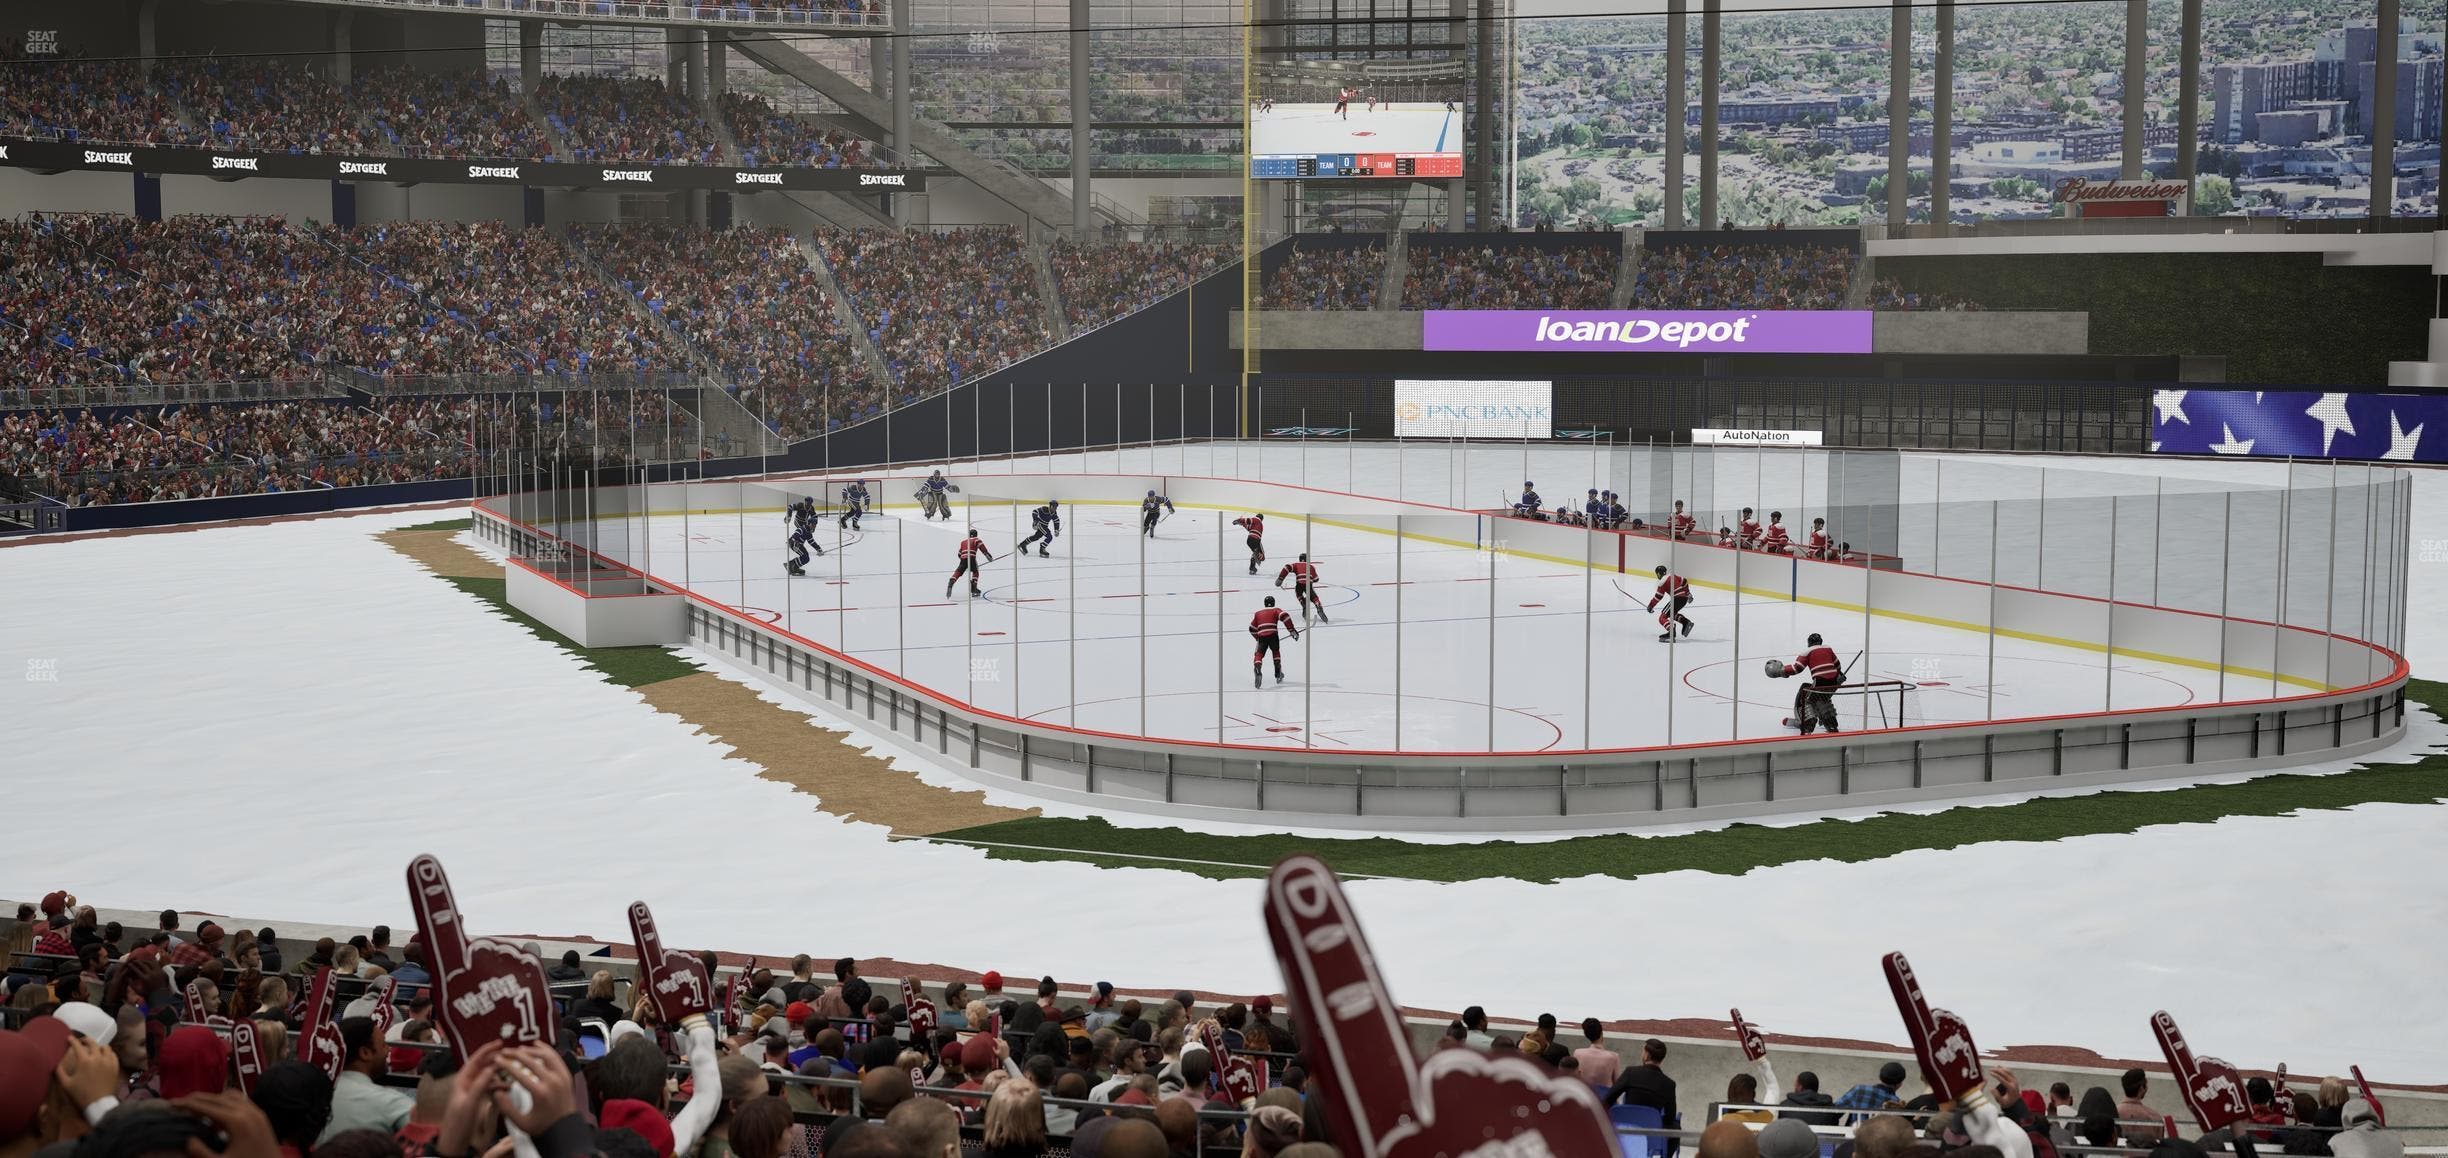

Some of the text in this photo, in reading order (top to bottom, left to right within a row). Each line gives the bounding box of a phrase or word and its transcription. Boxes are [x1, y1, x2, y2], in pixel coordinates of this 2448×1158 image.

[84, 149, 133, 166] SEATGEEK
[212, 155, 258, 171] SEATGEEK
[1343, 157, 1350, 167] 0
[1362, 157, 1369, 167] 0
[339, 160, 387, 175] SEATGEEK
[468, 164, 520, 179] SEATGEEK
[1319, 161, 1335, 170] TEAM
[1377, 161, 1393, 169] TEAM
[602, 168, 653, 183] SEATGEEK
[735, 171, 784, 185] SEATGEEK
[859, 173, 906, 187] SEATGEEK
[2055, 176, 2187, 202] Budweiser
[1535, 315, 1751, 348] loanDepot
[1722, 430, 1790, 441] AutoNation
